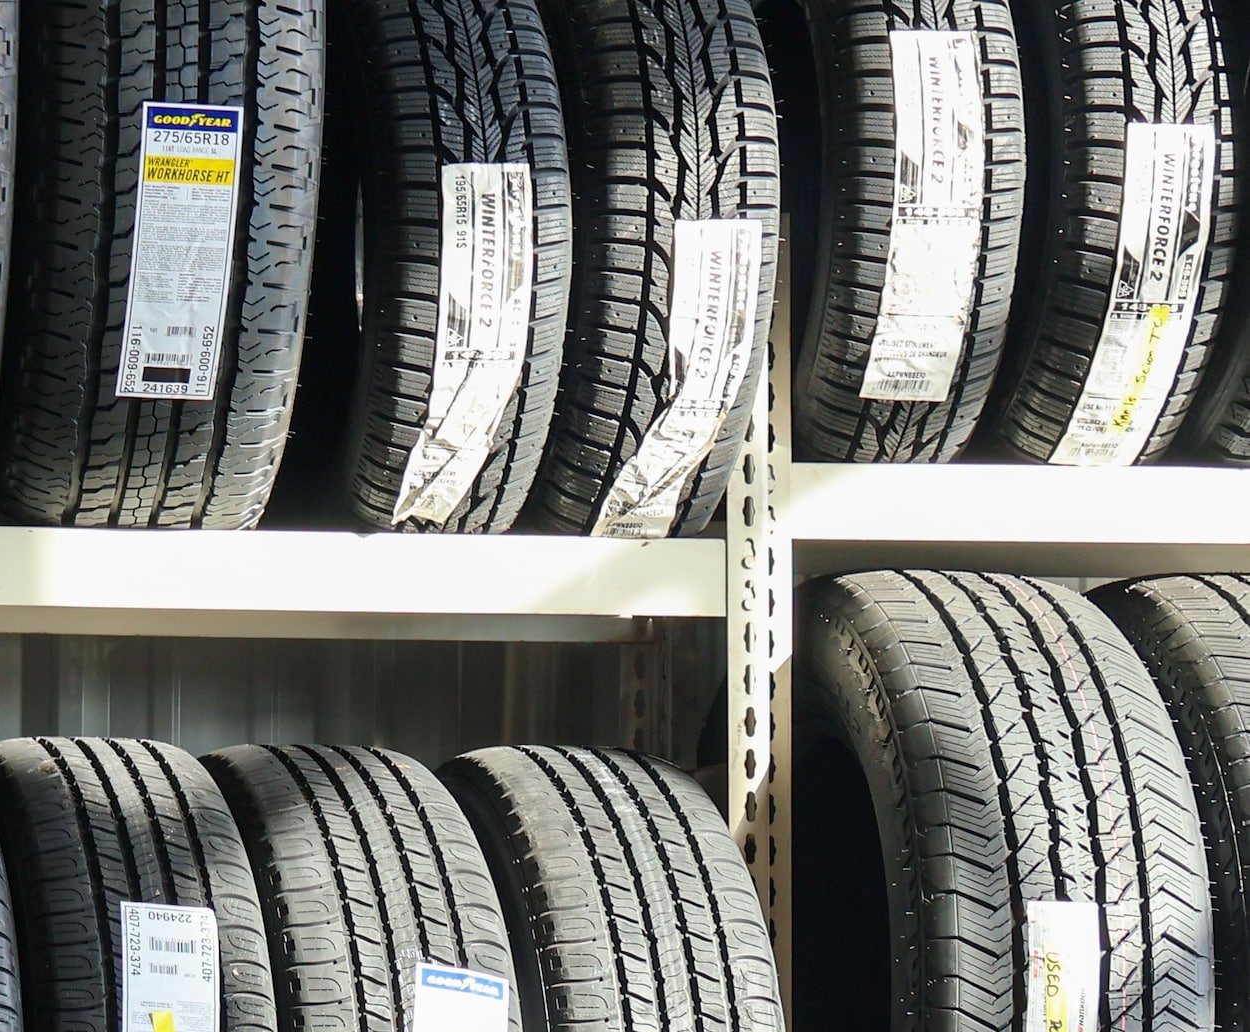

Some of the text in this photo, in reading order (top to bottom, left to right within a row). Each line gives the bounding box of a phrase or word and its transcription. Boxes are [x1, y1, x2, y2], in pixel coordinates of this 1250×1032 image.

[153, 113, 232, 127] GOODYEAR
[153, 130, 230, 146] 275/65R18
[147, 168, 231, 183] WORKHORSE HT
[148, 156, 190, 168] WRANGLER
[455, 175, 468, 249] 195/65R15 91S
[1150, 153, 1177, 282] WINTERFORCE 2
[479, 193, 496, 328] WINTERFORCE 2
[124, 325, 142, 392] 116-009-652
[195, 325, 215, 393] 116-009-652
[143, 383, 188, 394] 241639
[129, 908, 141, 976] 407-723-374
[148, 911, 192, 923] 224940
[200, 915, 213, 982] 407-723-374
[1046, 951, 1061, 998] USED
